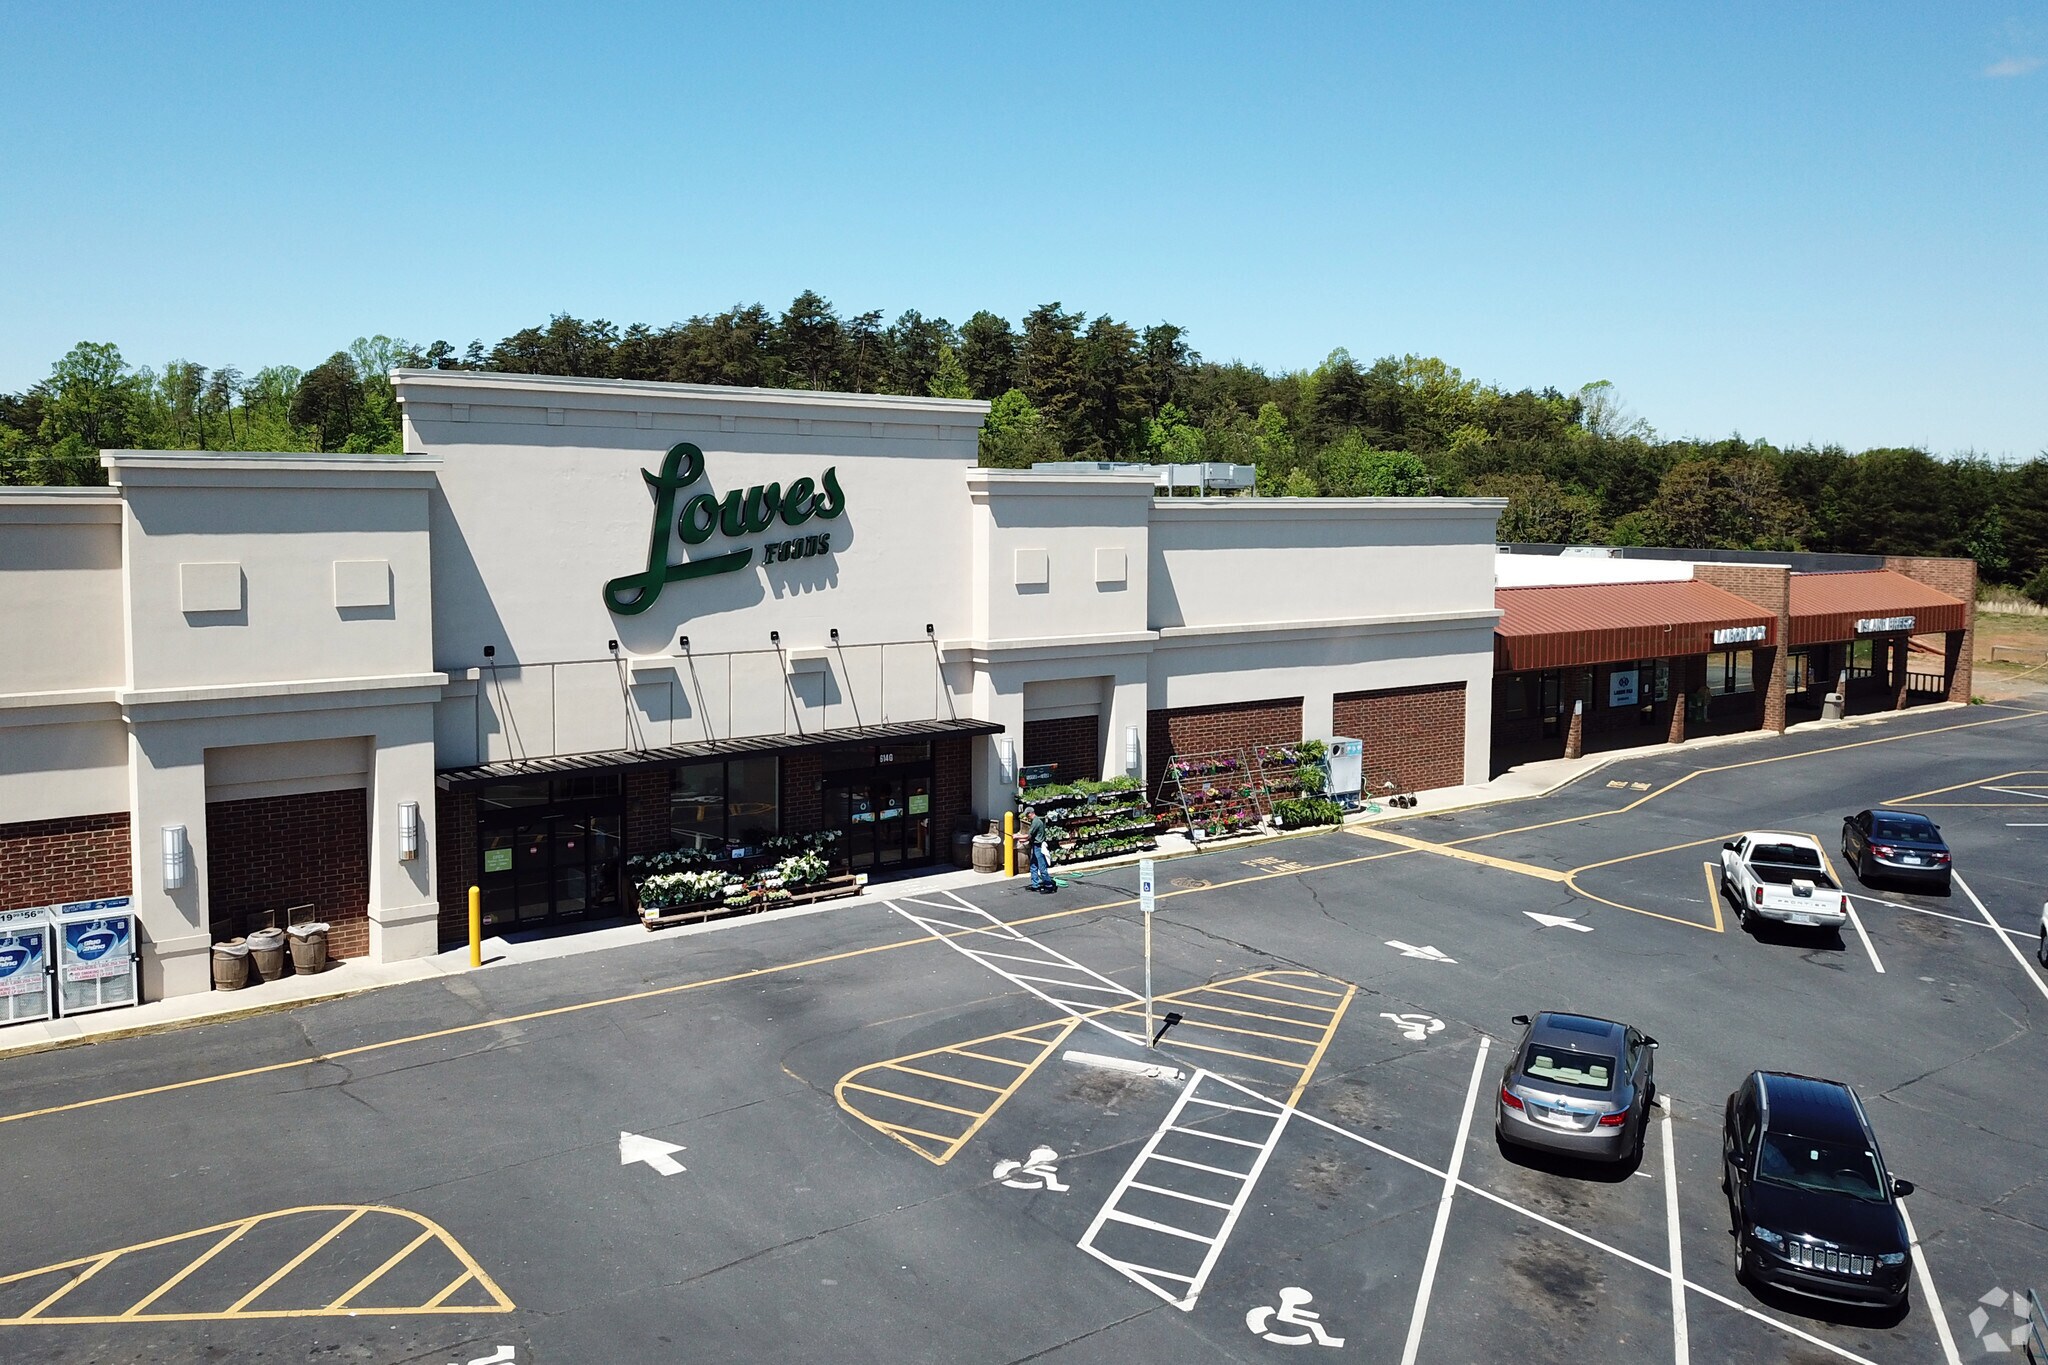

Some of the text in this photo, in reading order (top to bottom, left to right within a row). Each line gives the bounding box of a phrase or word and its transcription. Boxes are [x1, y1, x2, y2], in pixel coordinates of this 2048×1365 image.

[602, 442, 846, 615] Lowes
[762, 532, 831, 565] FOODS
[1713, 627, 1746, 645] LABOR
